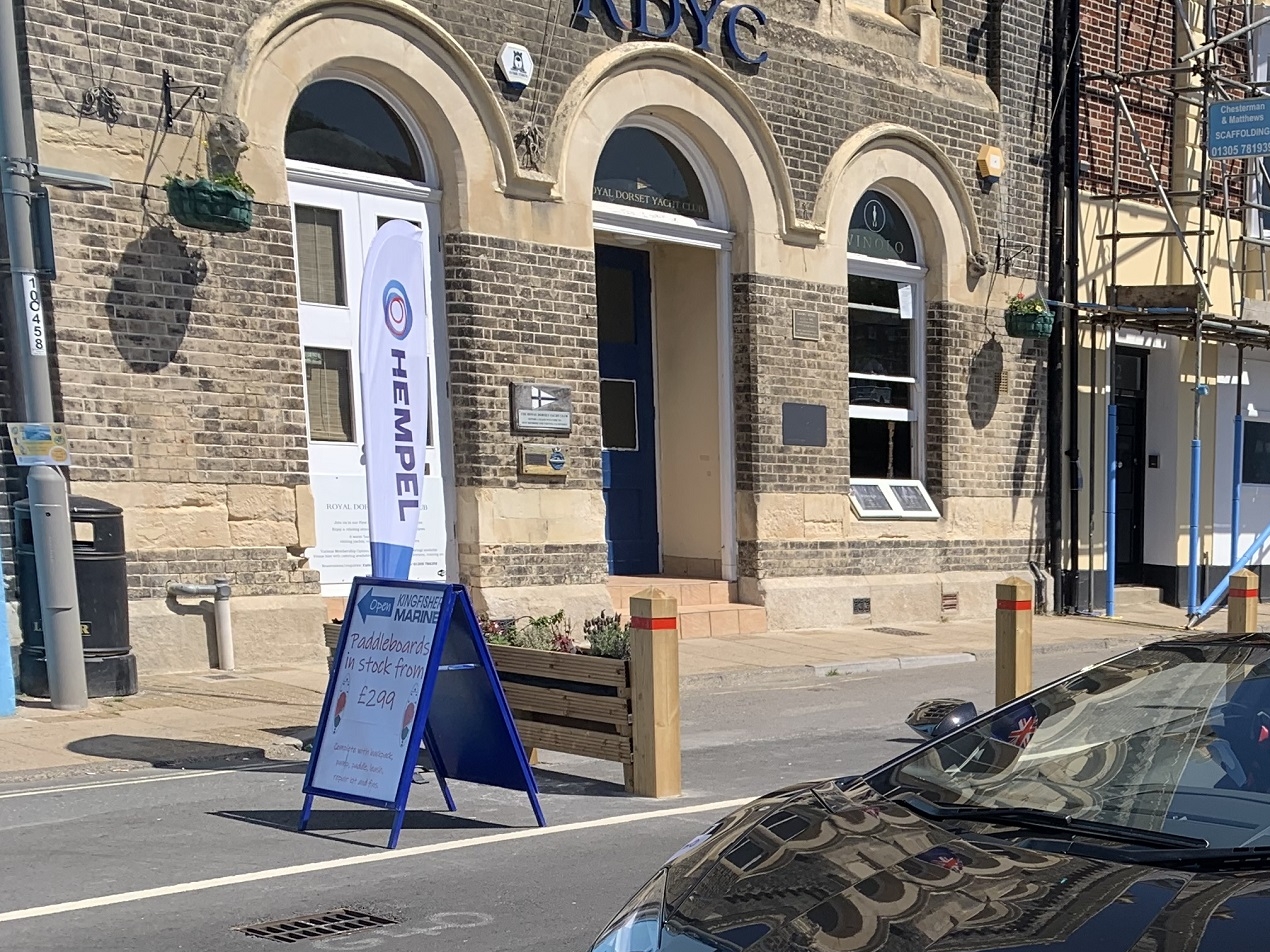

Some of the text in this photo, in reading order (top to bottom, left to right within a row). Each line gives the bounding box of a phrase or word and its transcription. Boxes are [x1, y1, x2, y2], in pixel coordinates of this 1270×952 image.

[1220, 103, 1266, 114] Chesterman
[1221, 114, 1264, 125] & Matthews
[1215, 127, 1270, 140] SCAFFOLDING
[1211, 145, 1239, 156] 01305
[615, 190, 650, 204] DORSET
[651, 196, 680, 209] YACHT
[29, 277, 43, 350] 100458
[391, 348, 420, 522] HEMPEL
[326, 503, 352, 511] ROYAL
[369, 599, 392, 612] Open
[397, 593, 443, 609] KINGFISHER
[394, 609, 440, 625] MARINE
[351, 631, 431, 656] Paddleboards
[344, 651, 425, 679] in stock from
[357, 685, 396, 711] £299
